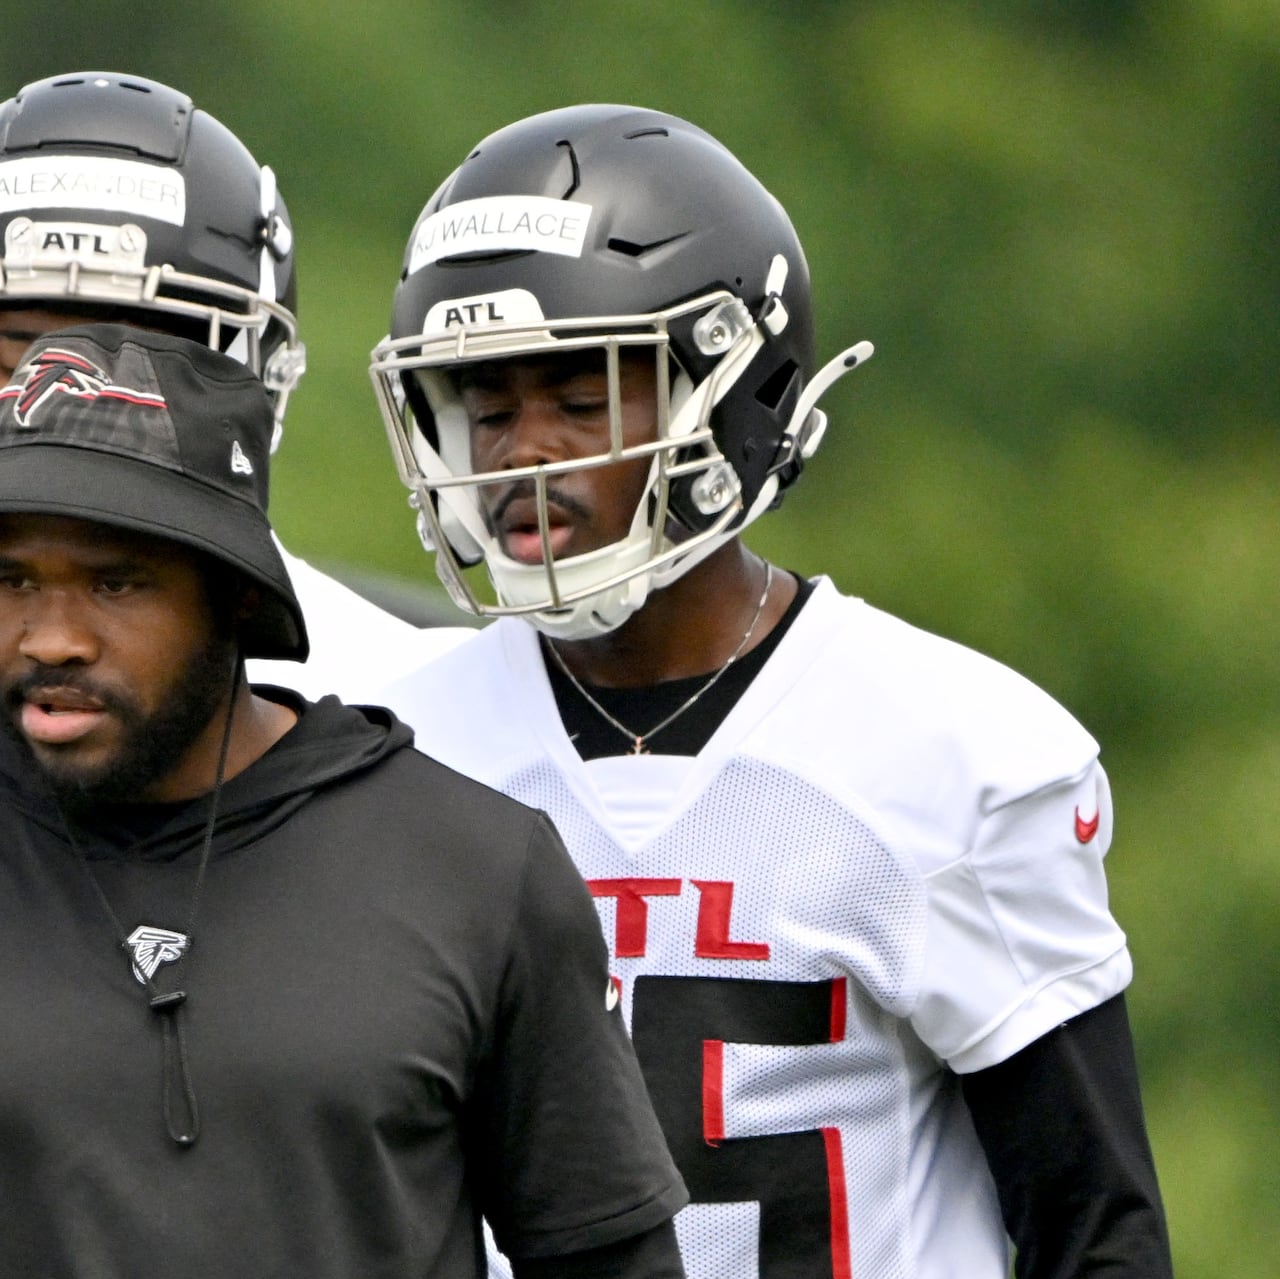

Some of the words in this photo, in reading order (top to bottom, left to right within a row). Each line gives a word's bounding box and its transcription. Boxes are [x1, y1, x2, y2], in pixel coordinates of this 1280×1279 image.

[442, 211, 582, 243] WALLACE
[42, 231, 110, 255] ATL
[444, 301, 505, 329] ATL
[586, 877, 770, 961] TL
